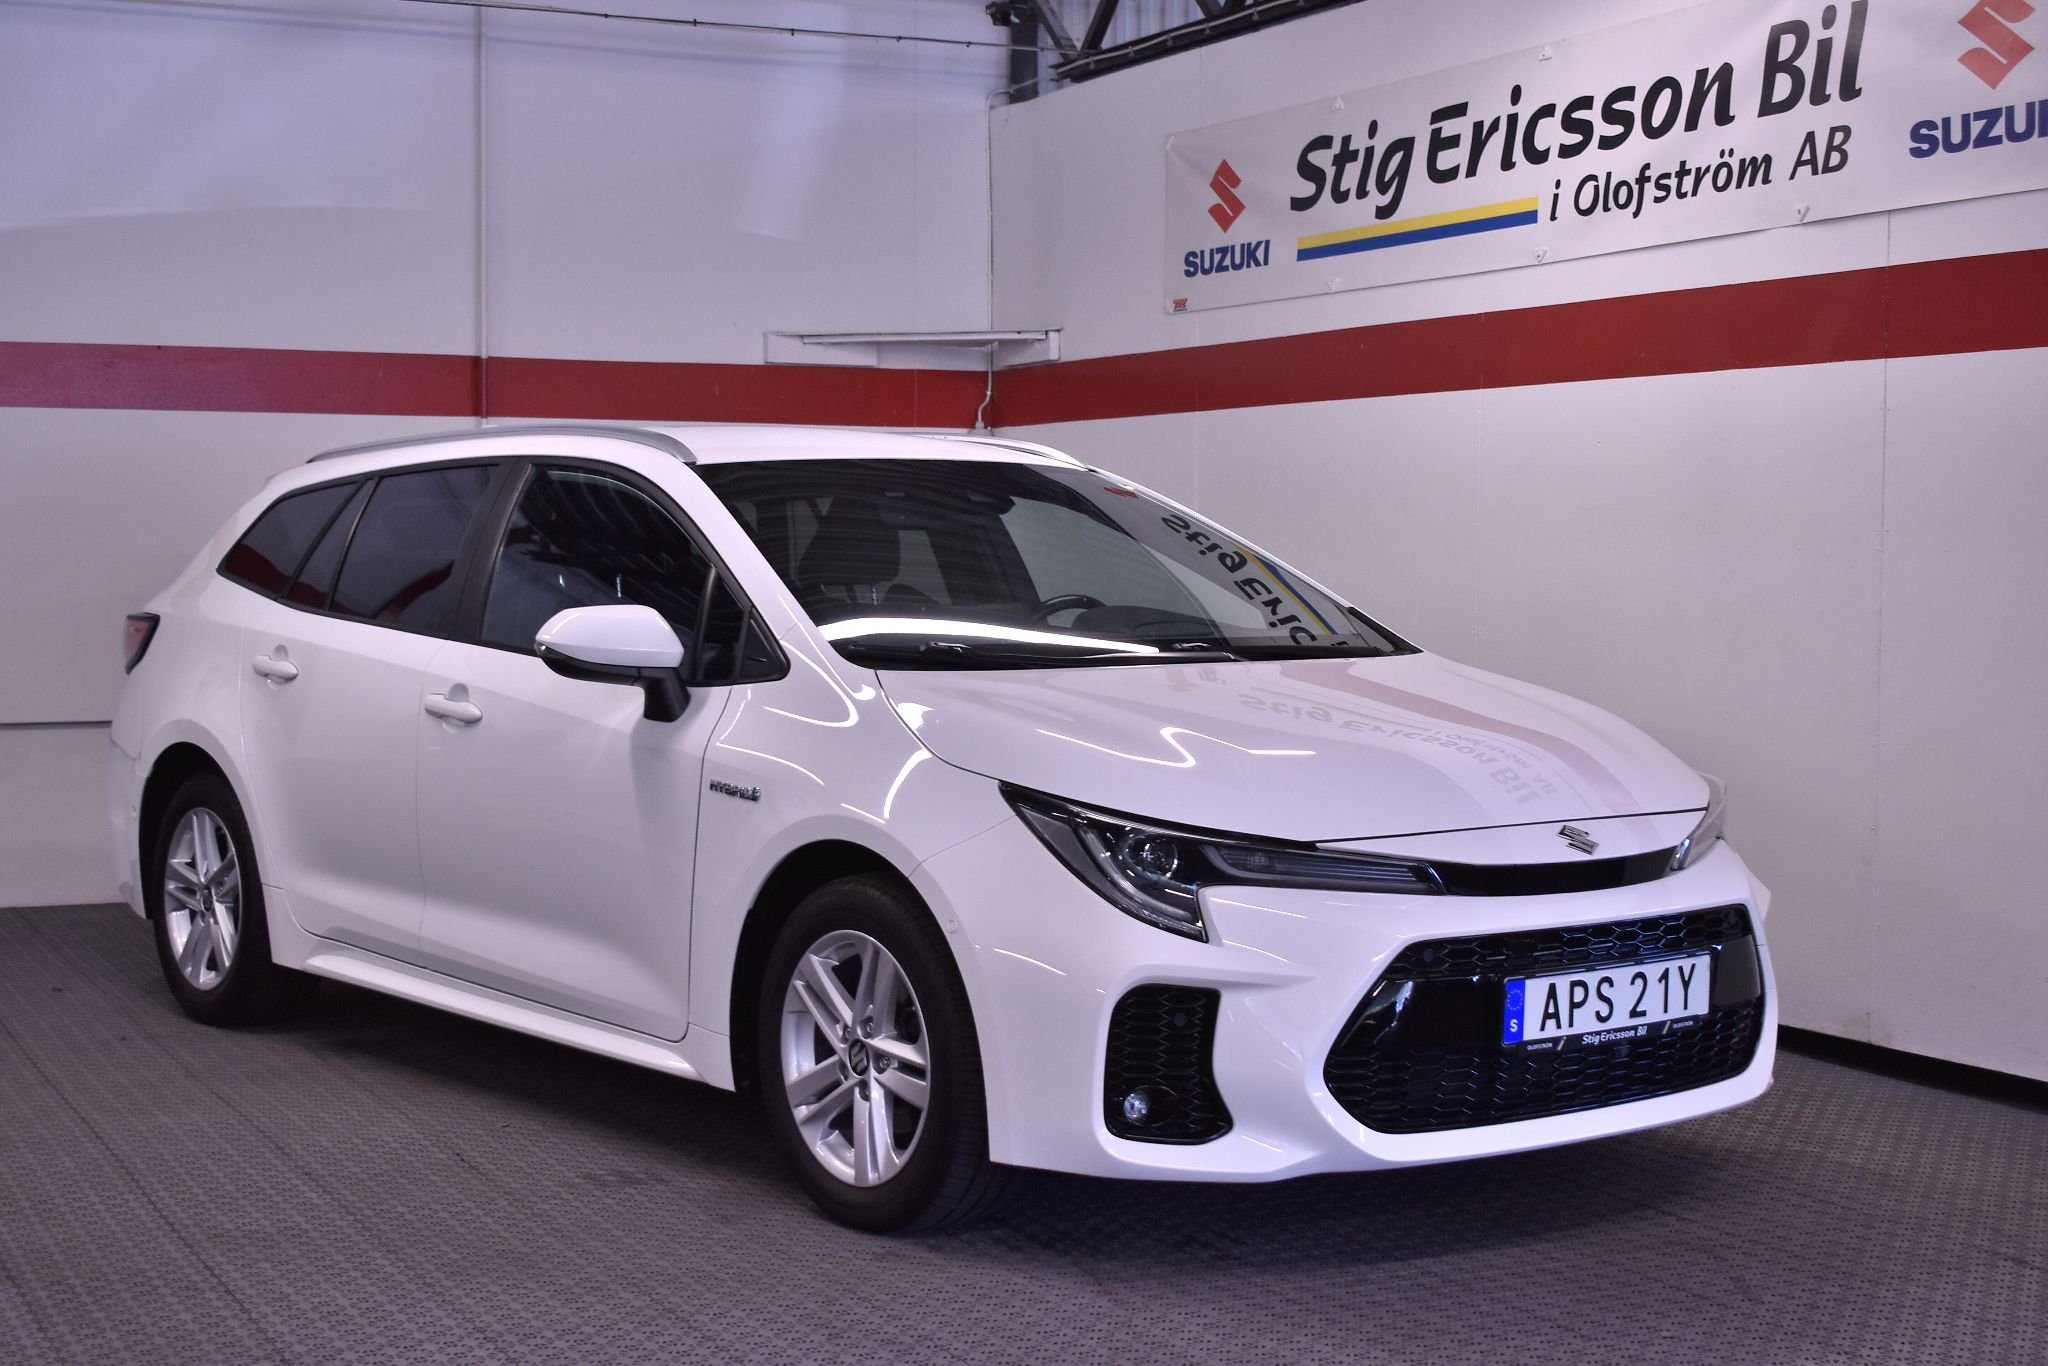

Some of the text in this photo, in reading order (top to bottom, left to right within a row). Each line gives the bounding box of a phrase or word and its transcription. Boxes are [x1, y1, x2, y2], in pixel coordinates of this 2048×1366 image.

[1290, 0, 1869, 220] Stig Ericsson Bil
[1549, 124, 1852, 222] i Olofström AB
[1183, 239, 1271, 278] SUZUKI
[1538, 962, 1697, 1032] APS 21Y
[1509, 1018, 1519, 1033] S
[1582, 1025, 1647, 1045] Stig Ericsson Bil
